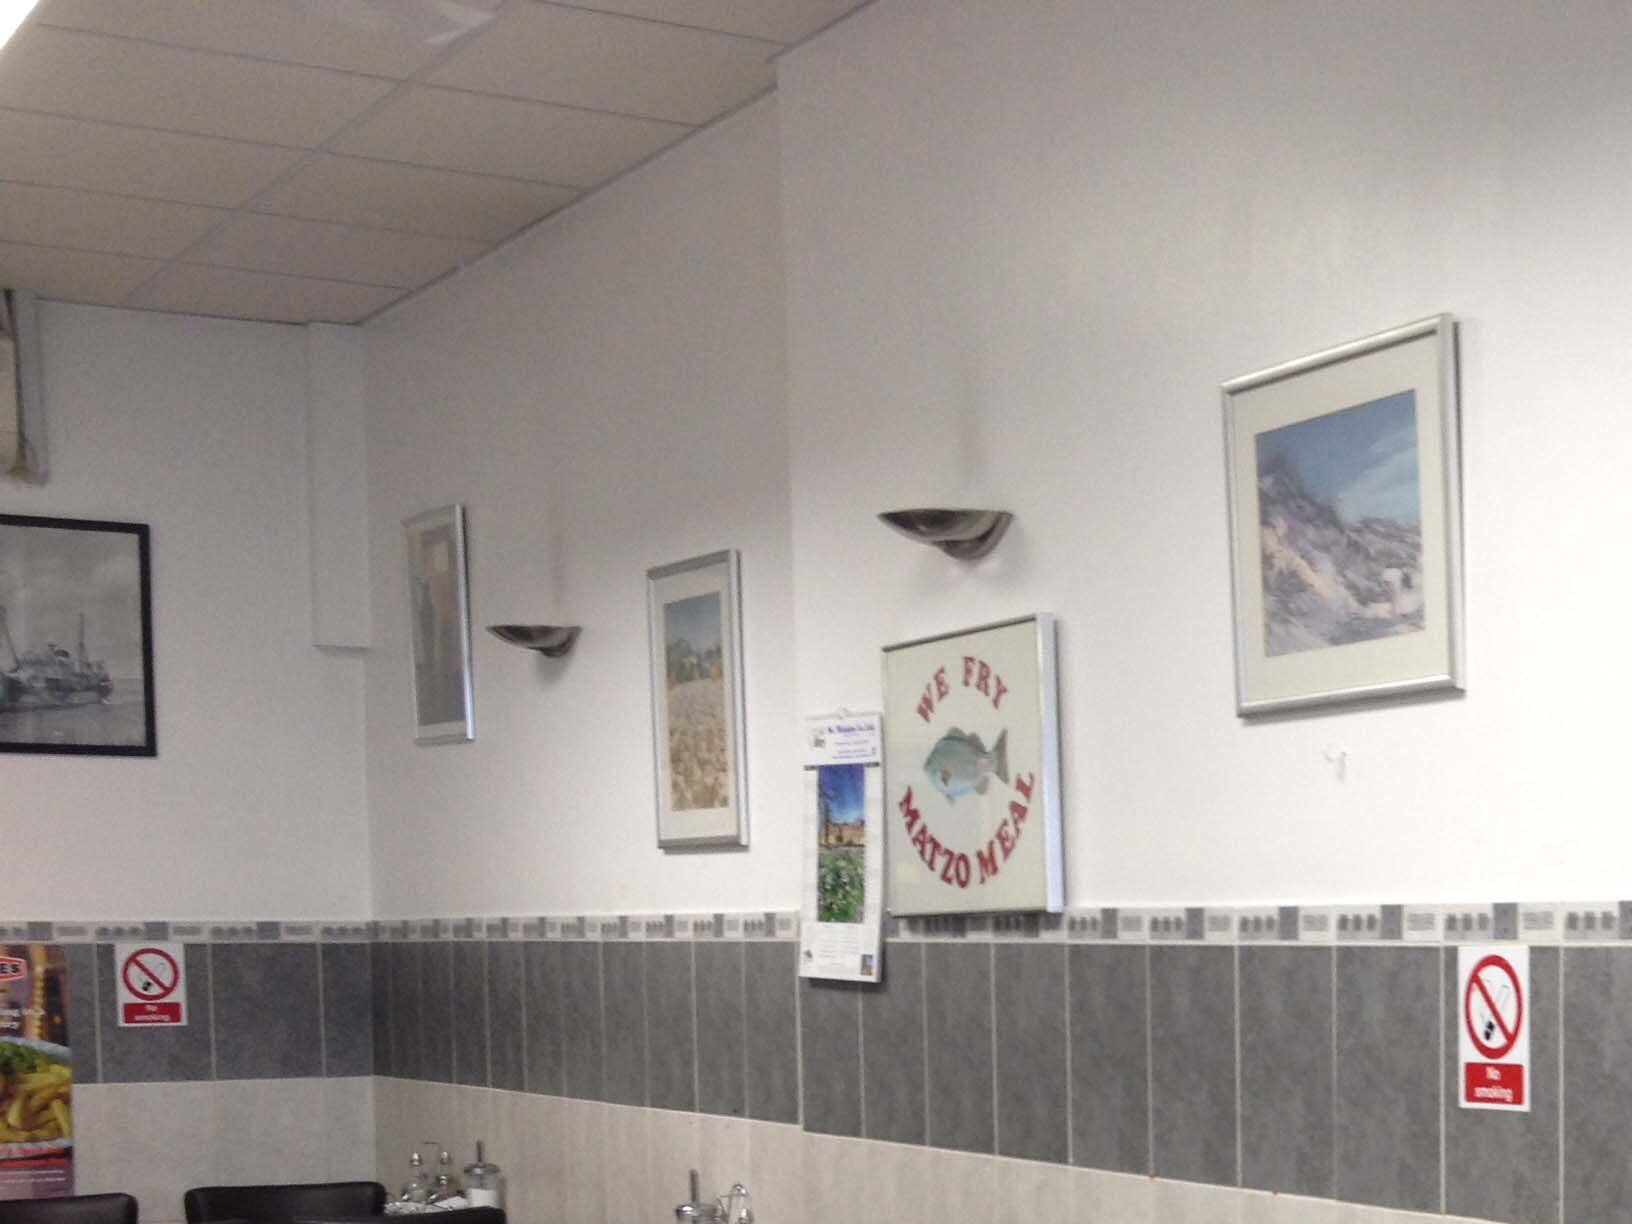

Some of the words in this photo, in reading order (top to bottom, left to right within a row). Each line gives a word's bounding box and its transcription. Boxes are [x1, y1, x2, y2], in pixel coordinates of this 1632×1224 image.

[915, 667, 949, 723] WE
[961, 656, 1009, 709] FRY
[899, 785, 972, 889] MATZO
[977, 772, 1036, 885] MEAL
